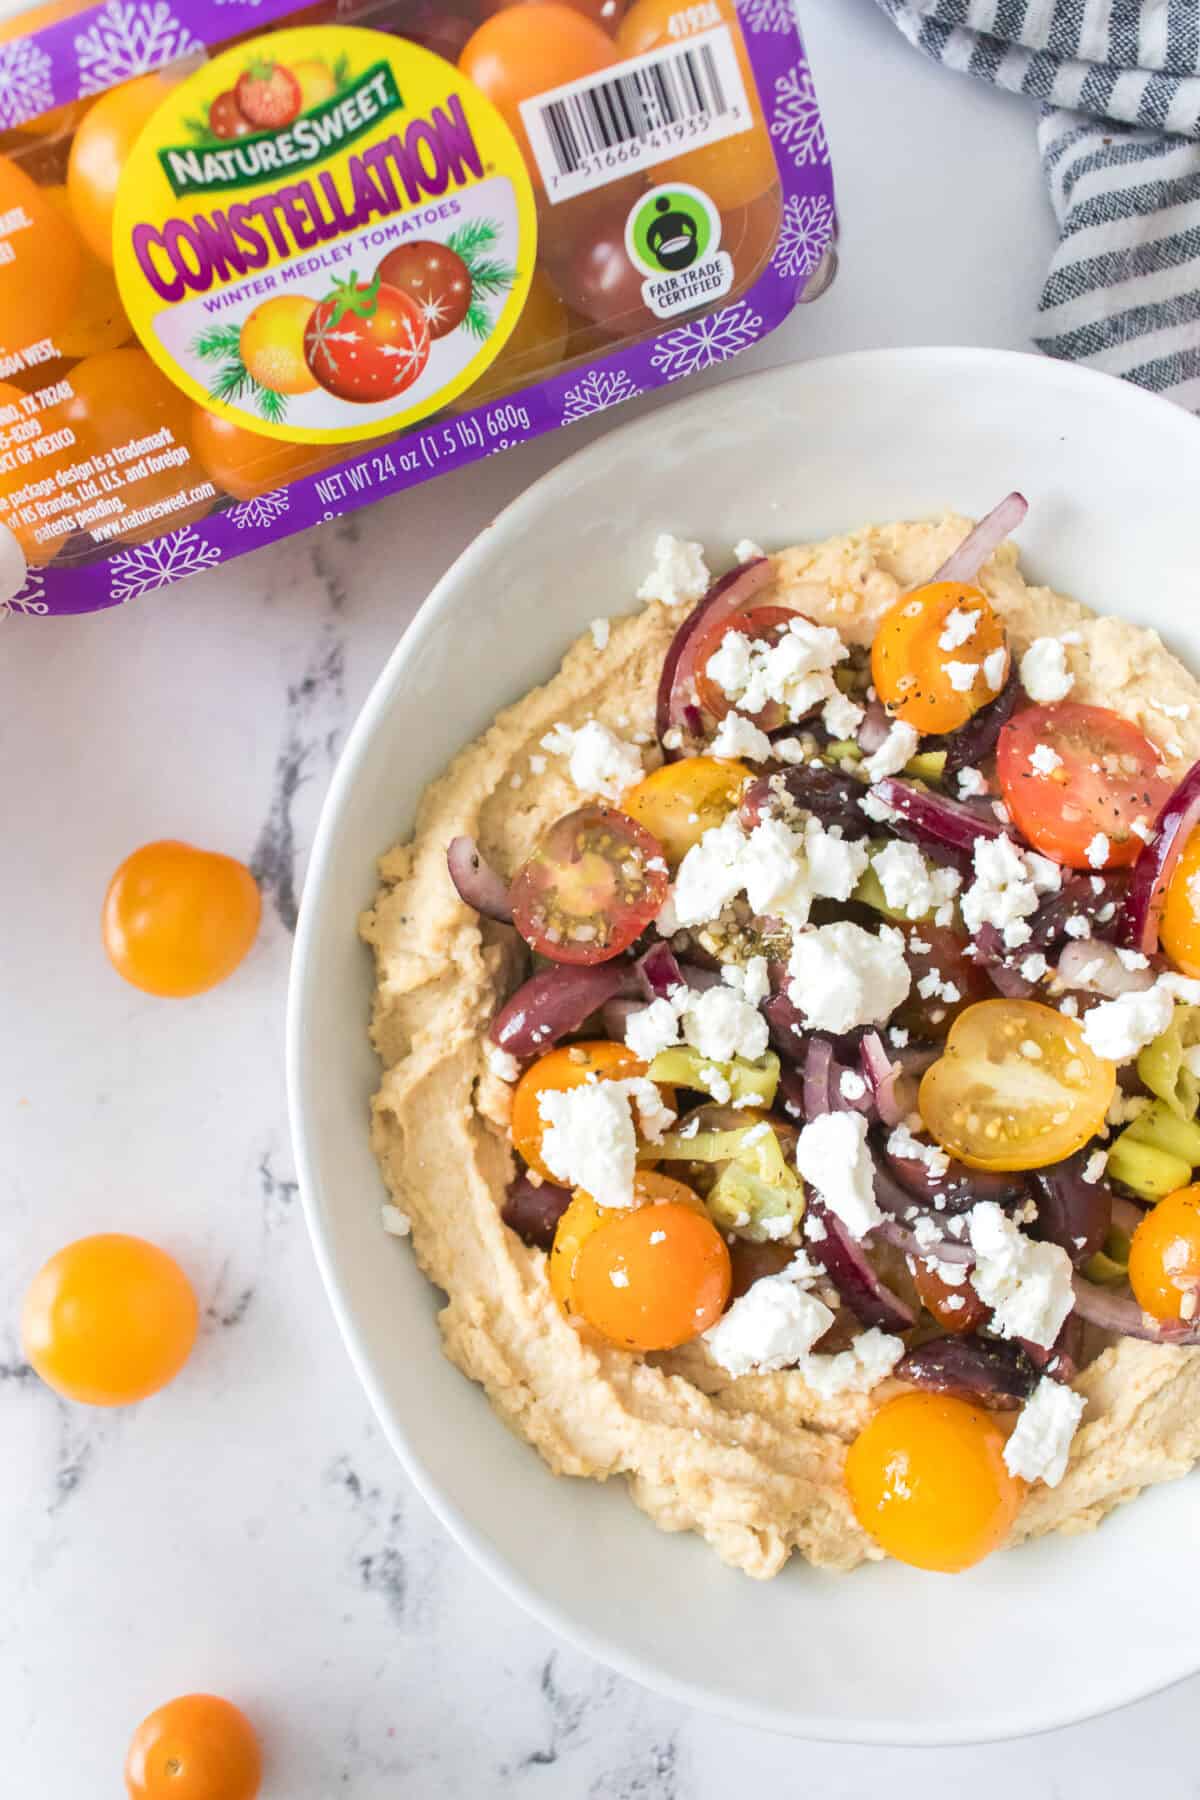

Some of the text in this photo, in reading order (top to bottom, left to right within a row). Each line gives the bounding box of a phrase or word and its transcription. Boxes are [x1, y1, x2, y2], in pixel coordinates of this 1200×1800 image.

[167, 71, 391, 185] NATURESWEET
[580, 143, 641, 177] 51666
[650, 116, 710, 149] 41935
[132, 94, 485, 303] CONSTELLATION
[203, 199, 462, 313] WINTER MEDLEY TOMATOES
[649, 259, 723, 298] FAIR TRADE
[658, 275, 722, 308] CERTIFIED
[21, 337, 62, 367] WEST,
[19, 394, 40, 415] TX
[9, 476, 57, 510] package
[56, 461, 95, 486] design
[93, 456, 106, 471] is
[105, 454, 115, 468] a
[112, 426, 175, 465] trademark
[16, 444, 32, 464] OF
[32, 426, 76, 457] MEXICO
[314, 404, 530, 505] NET WT 24 oz (1.5 lb) 680g
[8, 510, 20, 528] of
[36, 489, 81, 519] Brands,
[77, 480, 103, 501] Ltd.
[101, 470, 125, 492] U.S.
[124, 463, 149, 483] and
[144, 445, 190, 473] foreign
[90, 481, 215, 544] www.naturesweet.com
[34, 495, 126, 544] patents pending.
